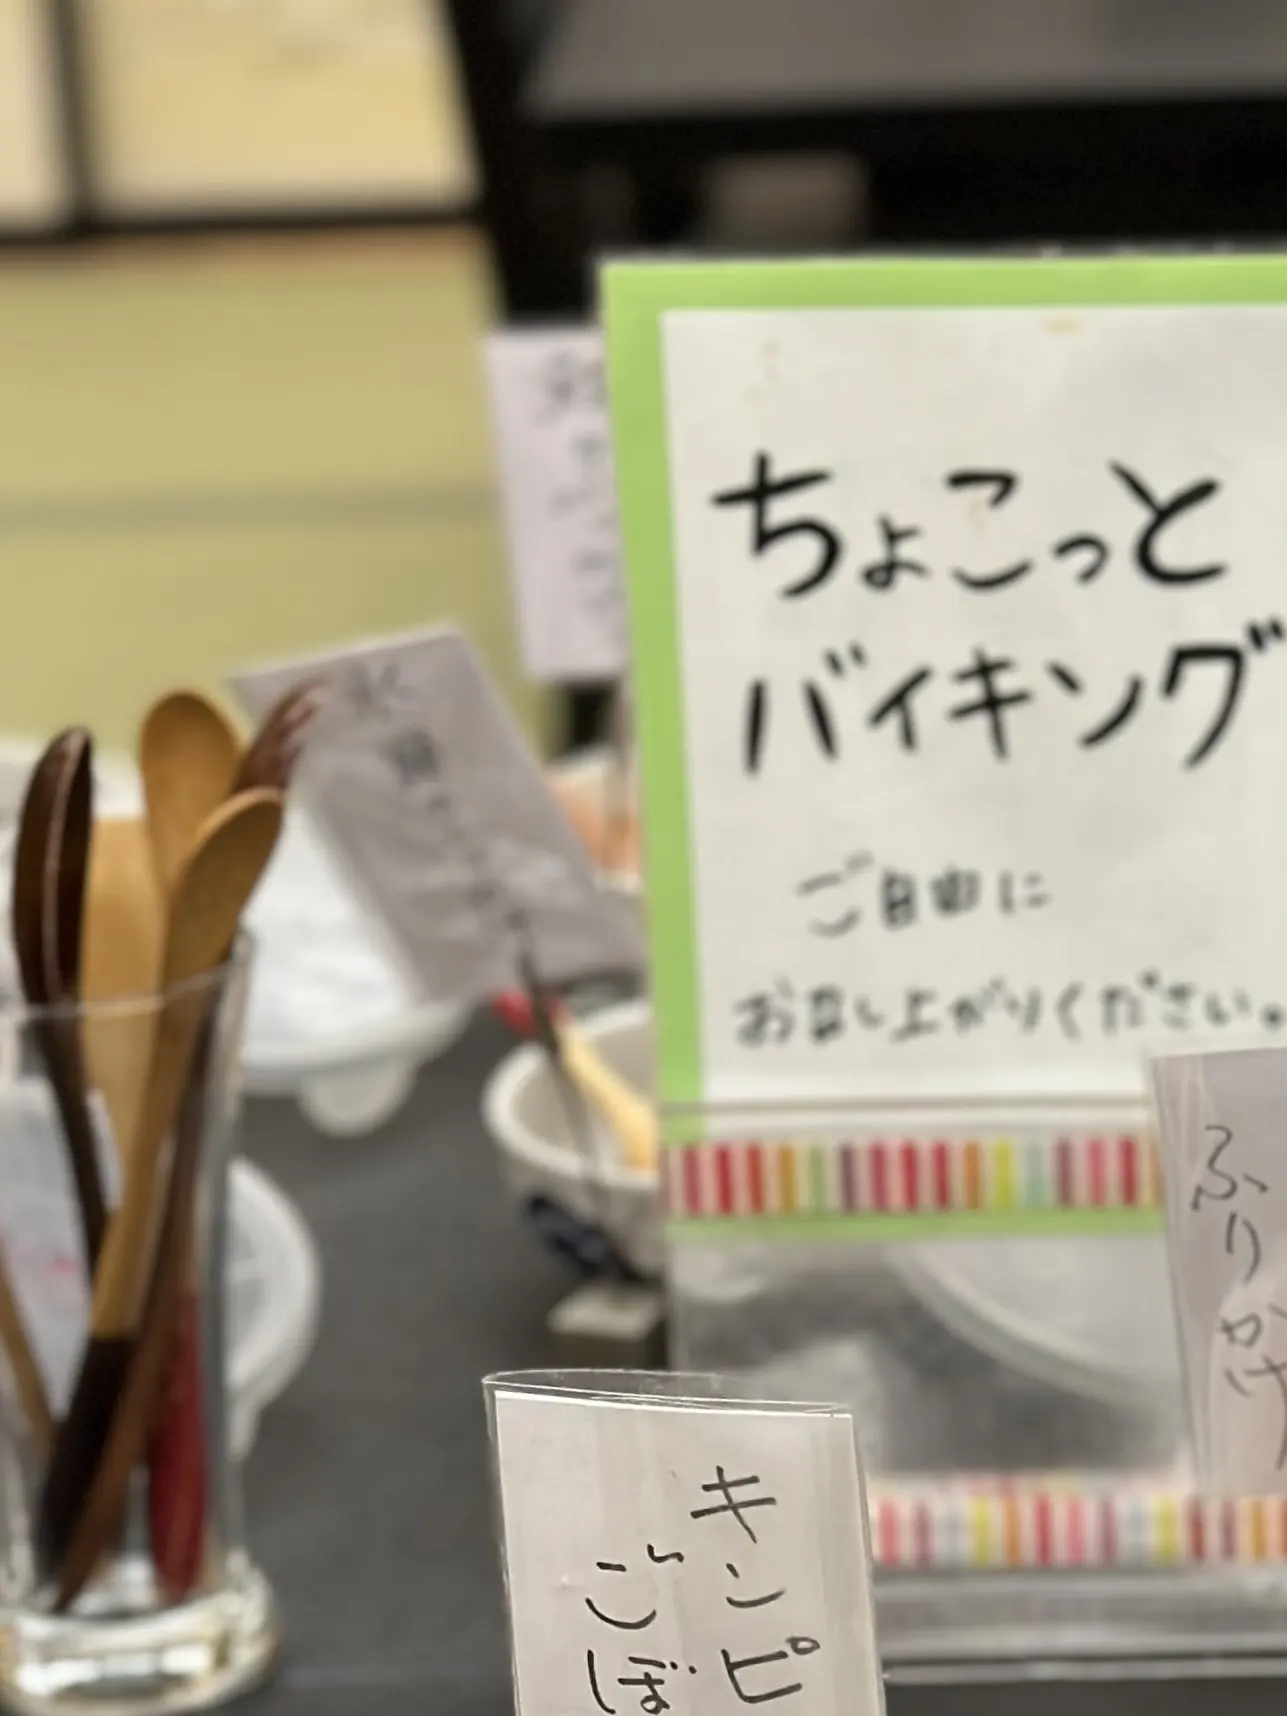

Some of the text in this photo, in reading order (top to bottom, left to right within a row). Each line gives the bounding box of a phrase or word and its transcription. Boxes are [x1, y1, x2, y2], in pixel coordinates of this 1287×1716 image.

[710, 452, 1229, 600] ちょこっと
[743, 617, 1287, 775] バイキング
[797, 850, 1050, 937] ご自由に
